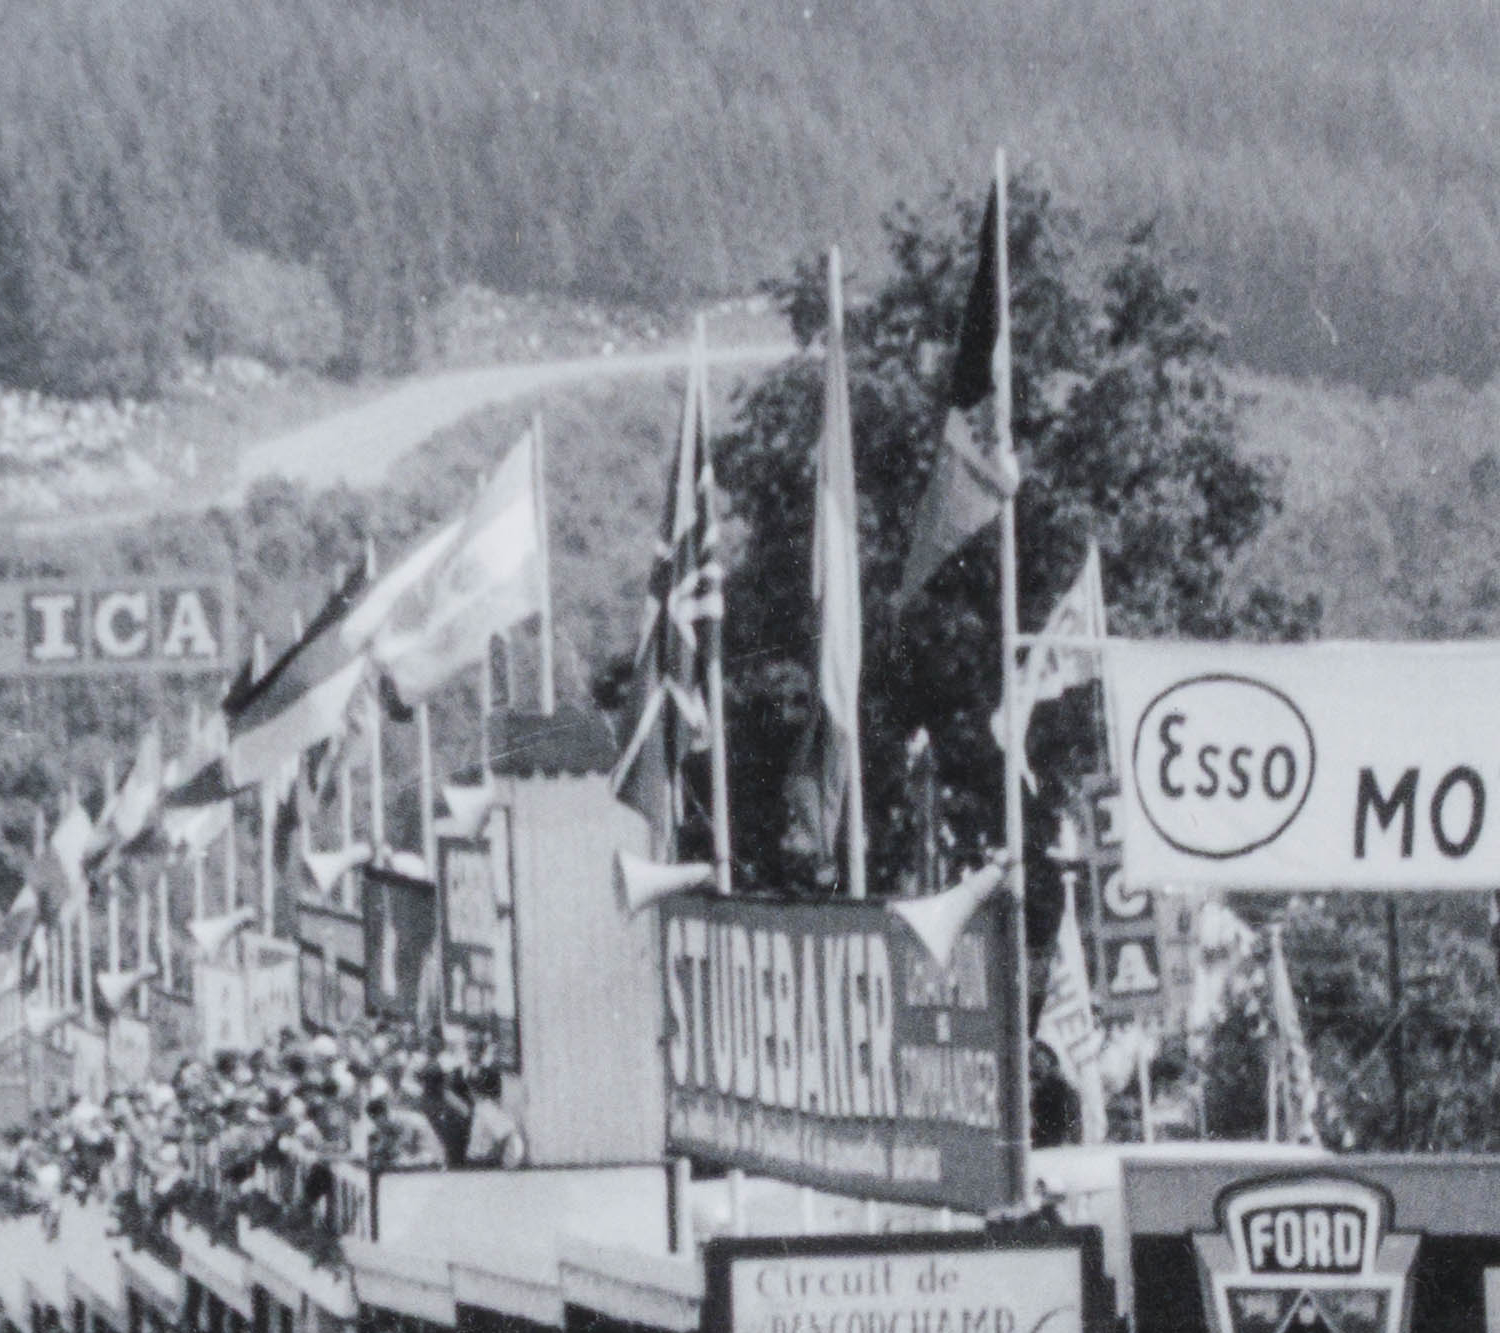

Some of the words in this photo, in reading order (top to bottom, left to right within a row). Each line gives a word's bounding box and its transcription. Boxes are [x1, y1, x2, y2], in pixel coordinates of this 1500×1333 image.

[31, 594, 217, 660] ICA
[667, 917, 899, 1118] STUDEBAKER
[1249, 1209, 1362, 1269] FORD
[756, 1258, 893, 1298] Circuit
[915, 1258, 960, 1295] de
